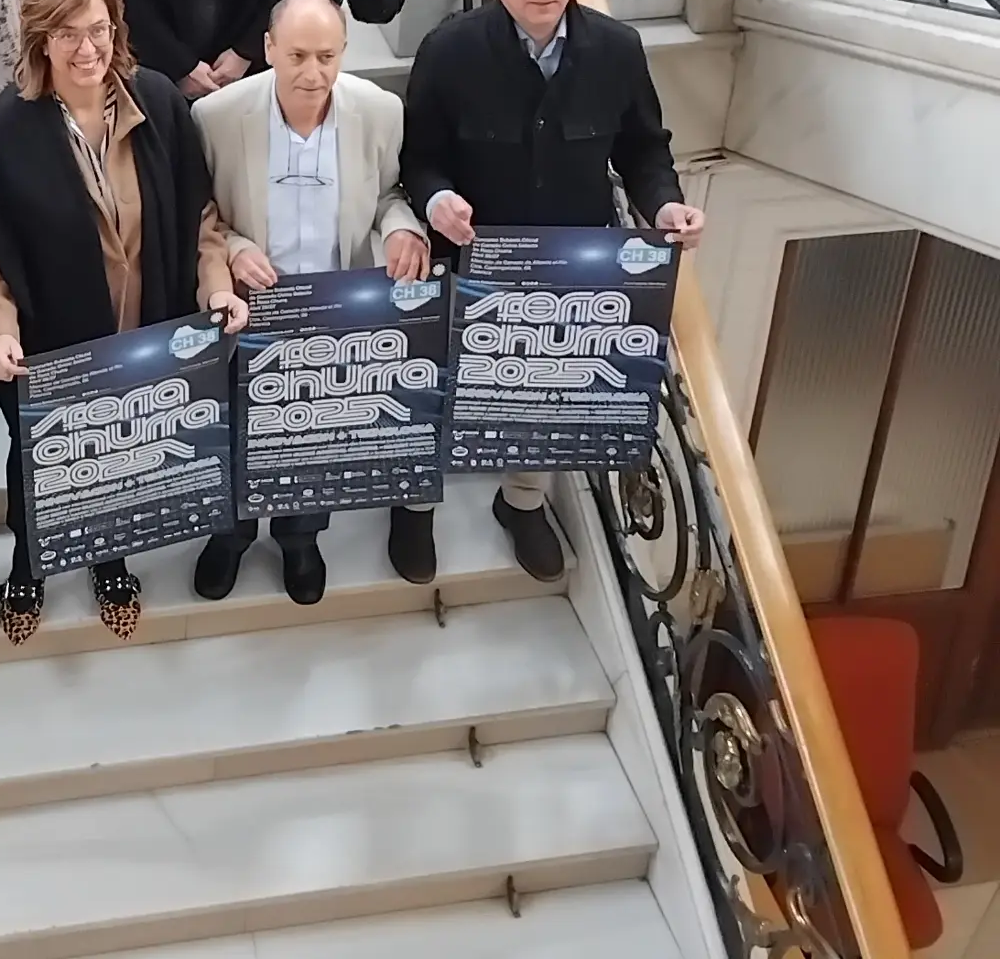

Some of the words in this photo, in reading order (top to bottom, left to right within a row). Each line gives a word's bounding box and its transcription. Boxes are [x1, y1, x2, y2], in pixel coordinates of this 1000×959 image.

[620, 250, 643, 262] CH
[648, 250, 667, 262] 38
[393, 288, 416, 300] CH
[171, 336, 194, 350] CH
[457, 353, 627, 389] 2025
[247, 393, 411, 435] 2025
[33, 438, 195, 497] 2025
